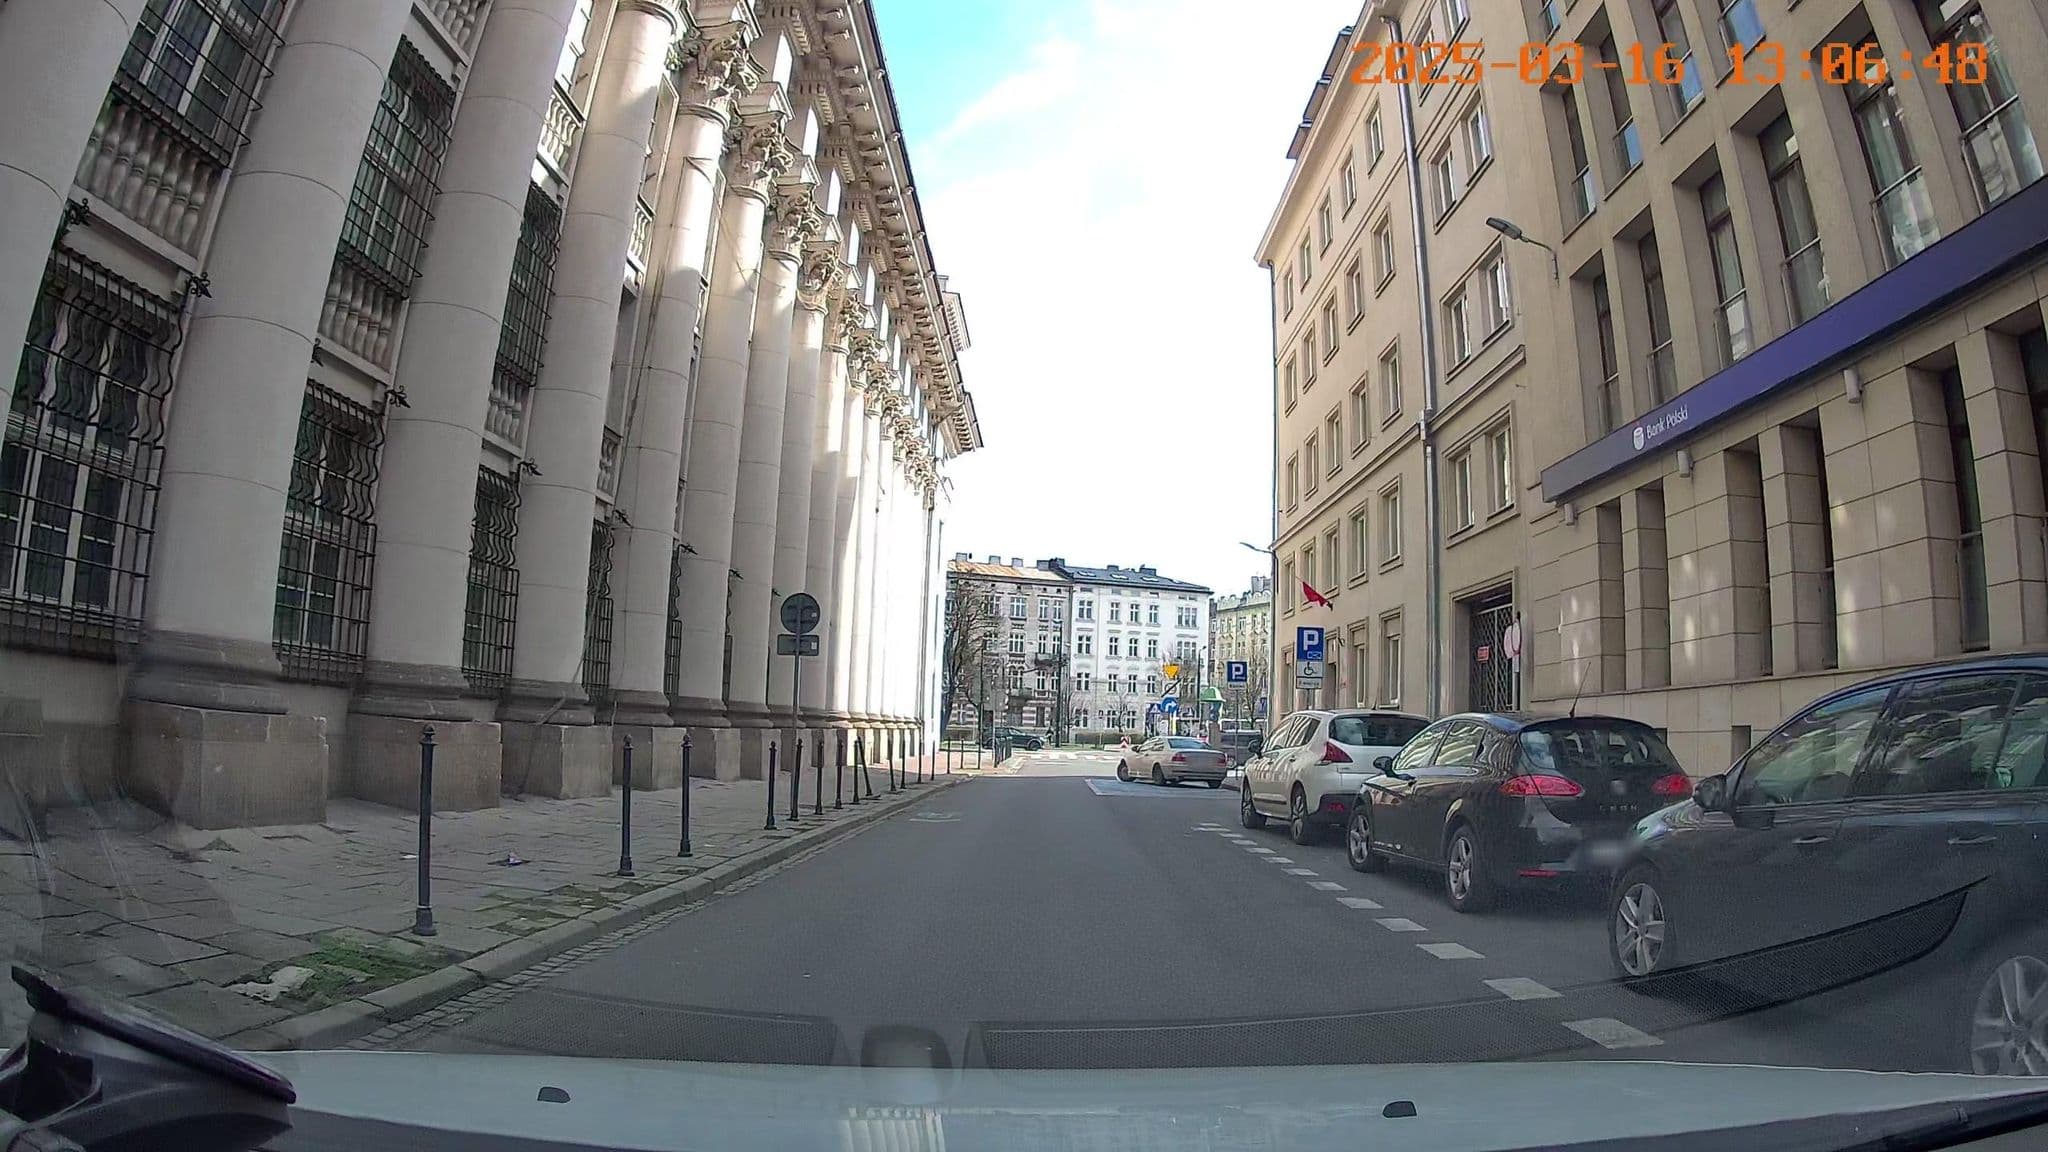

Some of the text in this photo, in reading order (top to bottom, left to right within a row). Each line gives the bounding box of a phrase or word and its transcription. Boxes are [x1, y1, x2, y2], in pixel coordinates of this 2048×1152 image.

[1646, 404, 1688, 439] Bank Polski
[1303, 629, 1319, 650] P
[1231, 663, 1244, 680] P
